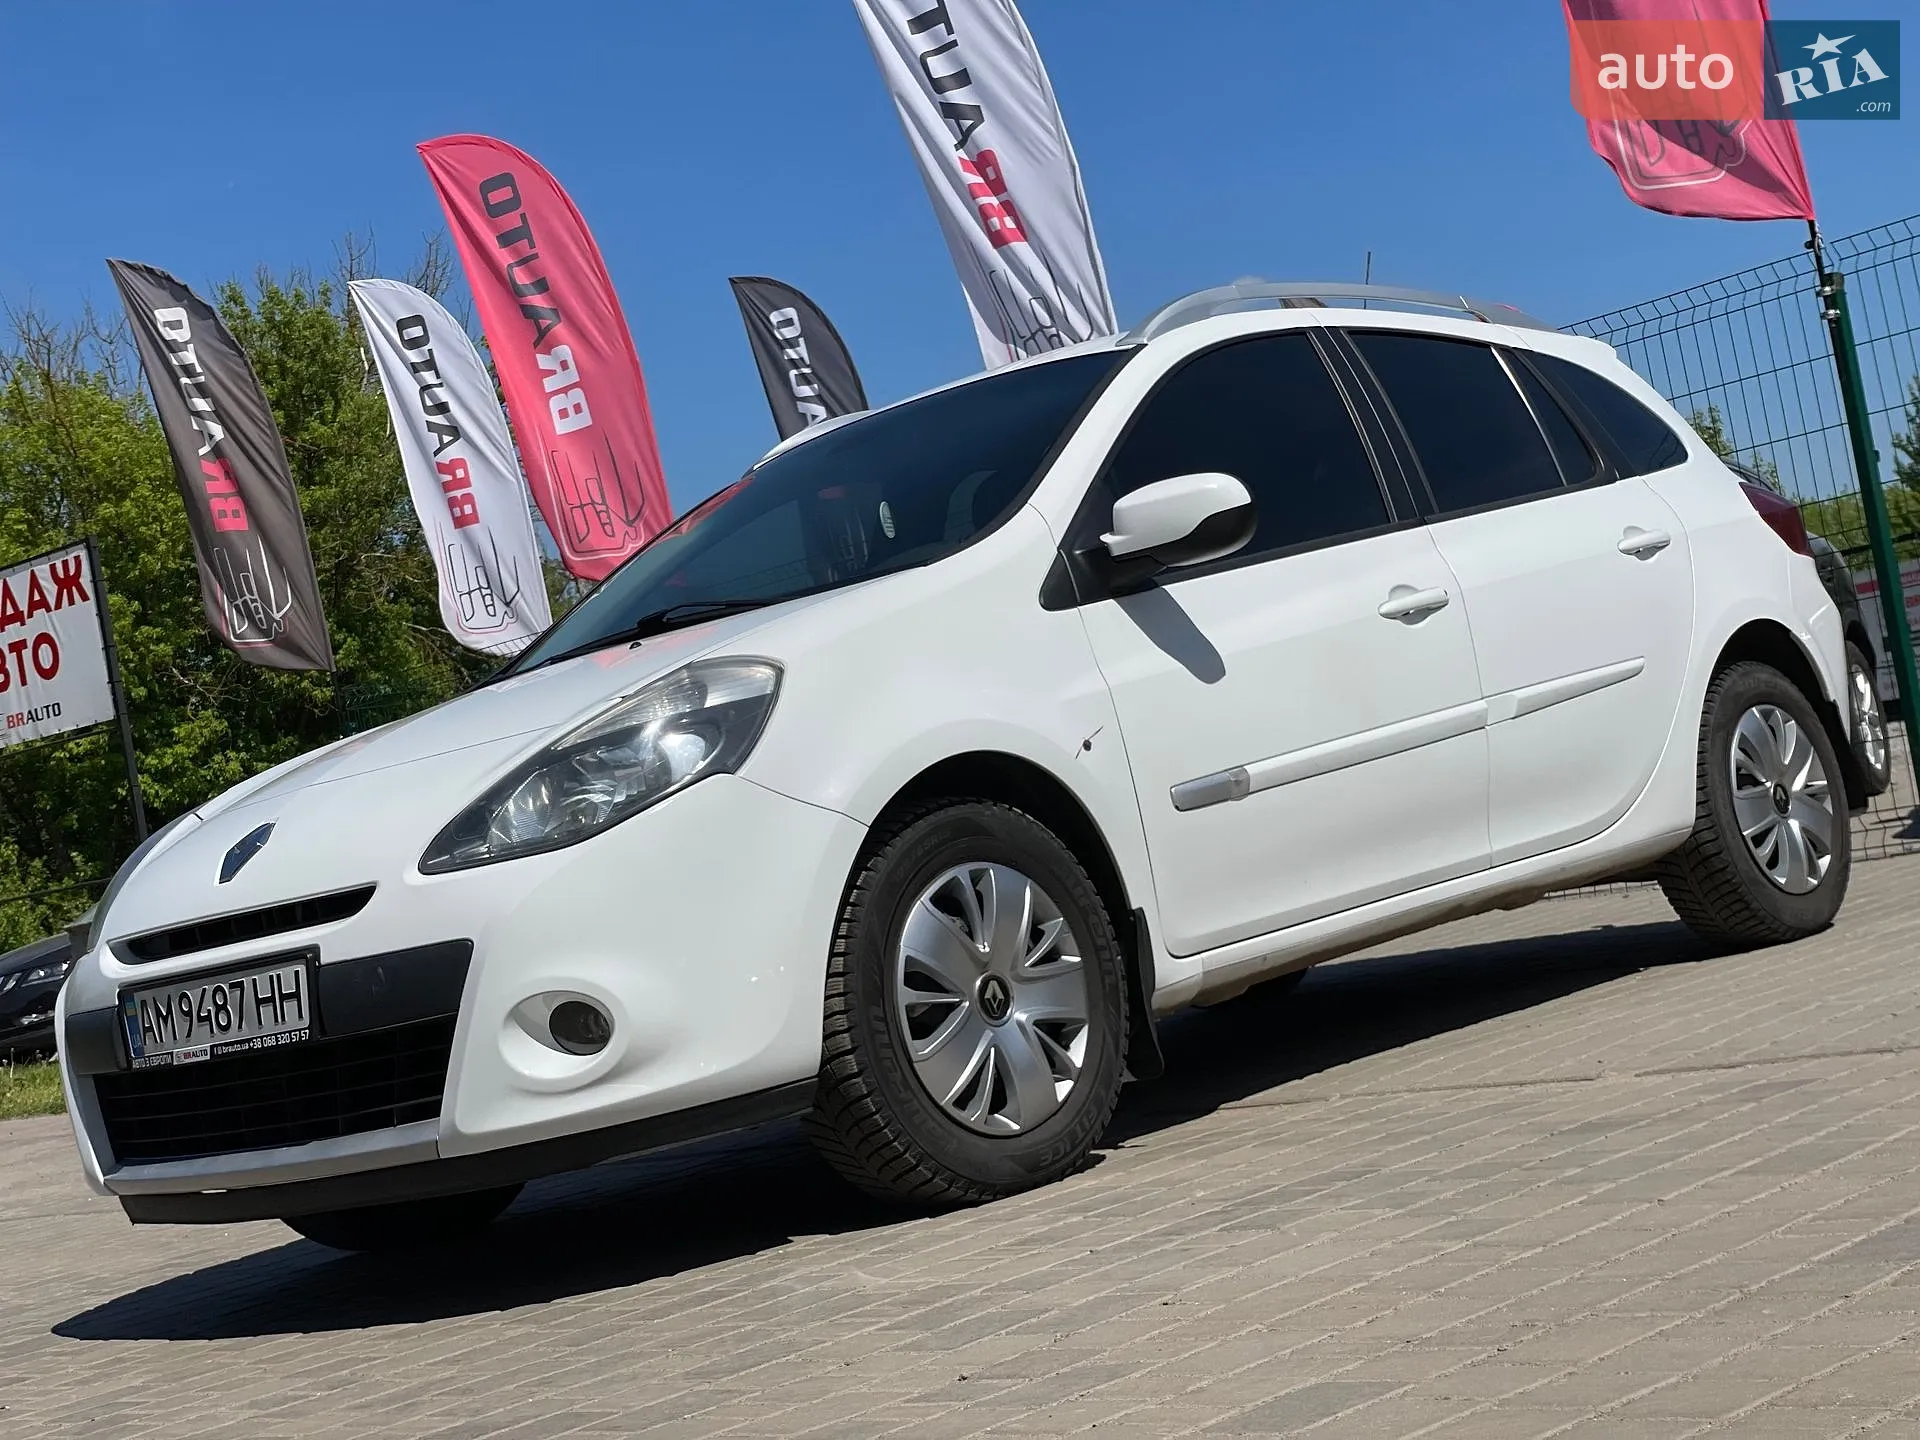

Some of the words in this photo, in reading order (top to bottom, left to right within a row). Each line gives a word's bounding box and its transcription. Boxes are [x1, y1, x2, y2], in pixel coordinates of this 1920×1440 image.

[6, 702, 62, 729] BRAUTO
[183, 1048, 209, 1060] BRAUTO
[222, 1042, 249, 1054] brauto.ua
[249, 1038, 262, 1049] +38
[262, 1035, 276, 1048] 068
[277, 1033, 291, 1045] 320
[291, 1031, 300, 1043] 57
[300, 1029, 310, 1041] 57
